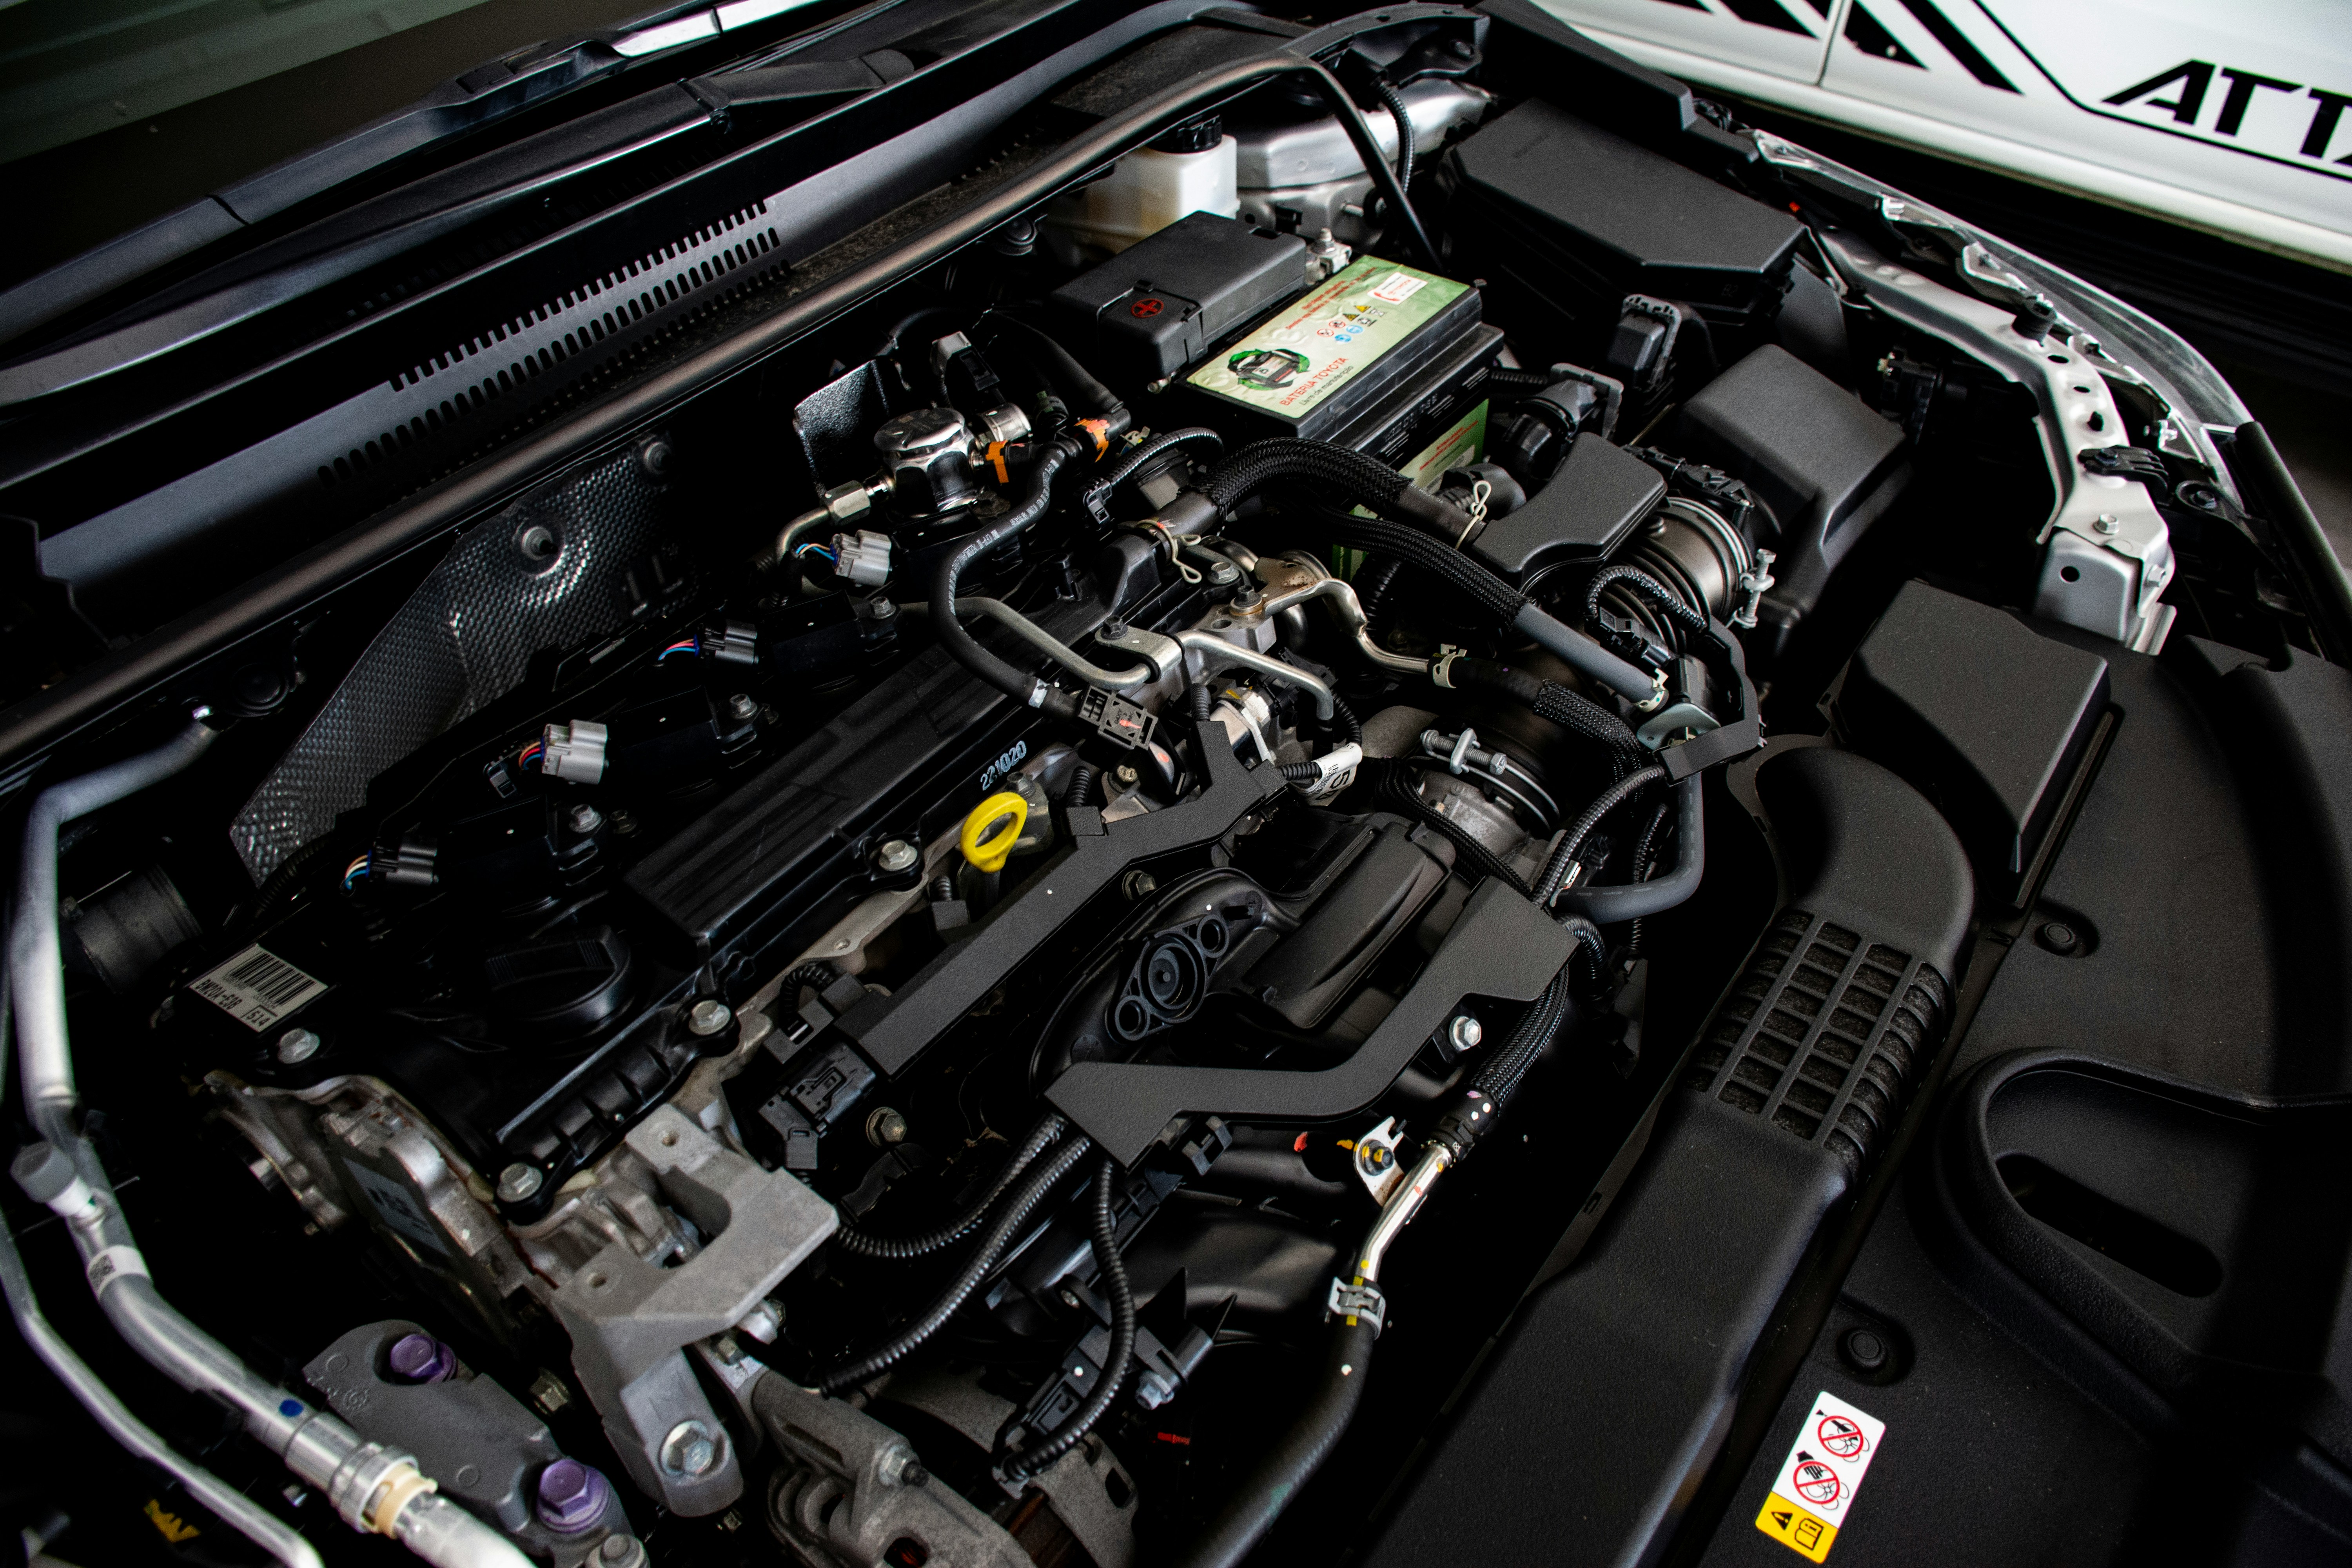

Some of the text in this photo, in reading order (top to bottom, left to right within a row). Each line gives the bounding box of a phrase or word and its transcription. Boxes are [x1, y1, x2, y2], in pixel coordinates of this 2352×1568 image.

[2102, 59, 2352, 165] ATT
[1279, 357, 1348, 406] BATERIA TOYOTA
[980, 740, 1027, 791] 221020
[245, 1009, 272, 1027] 514
